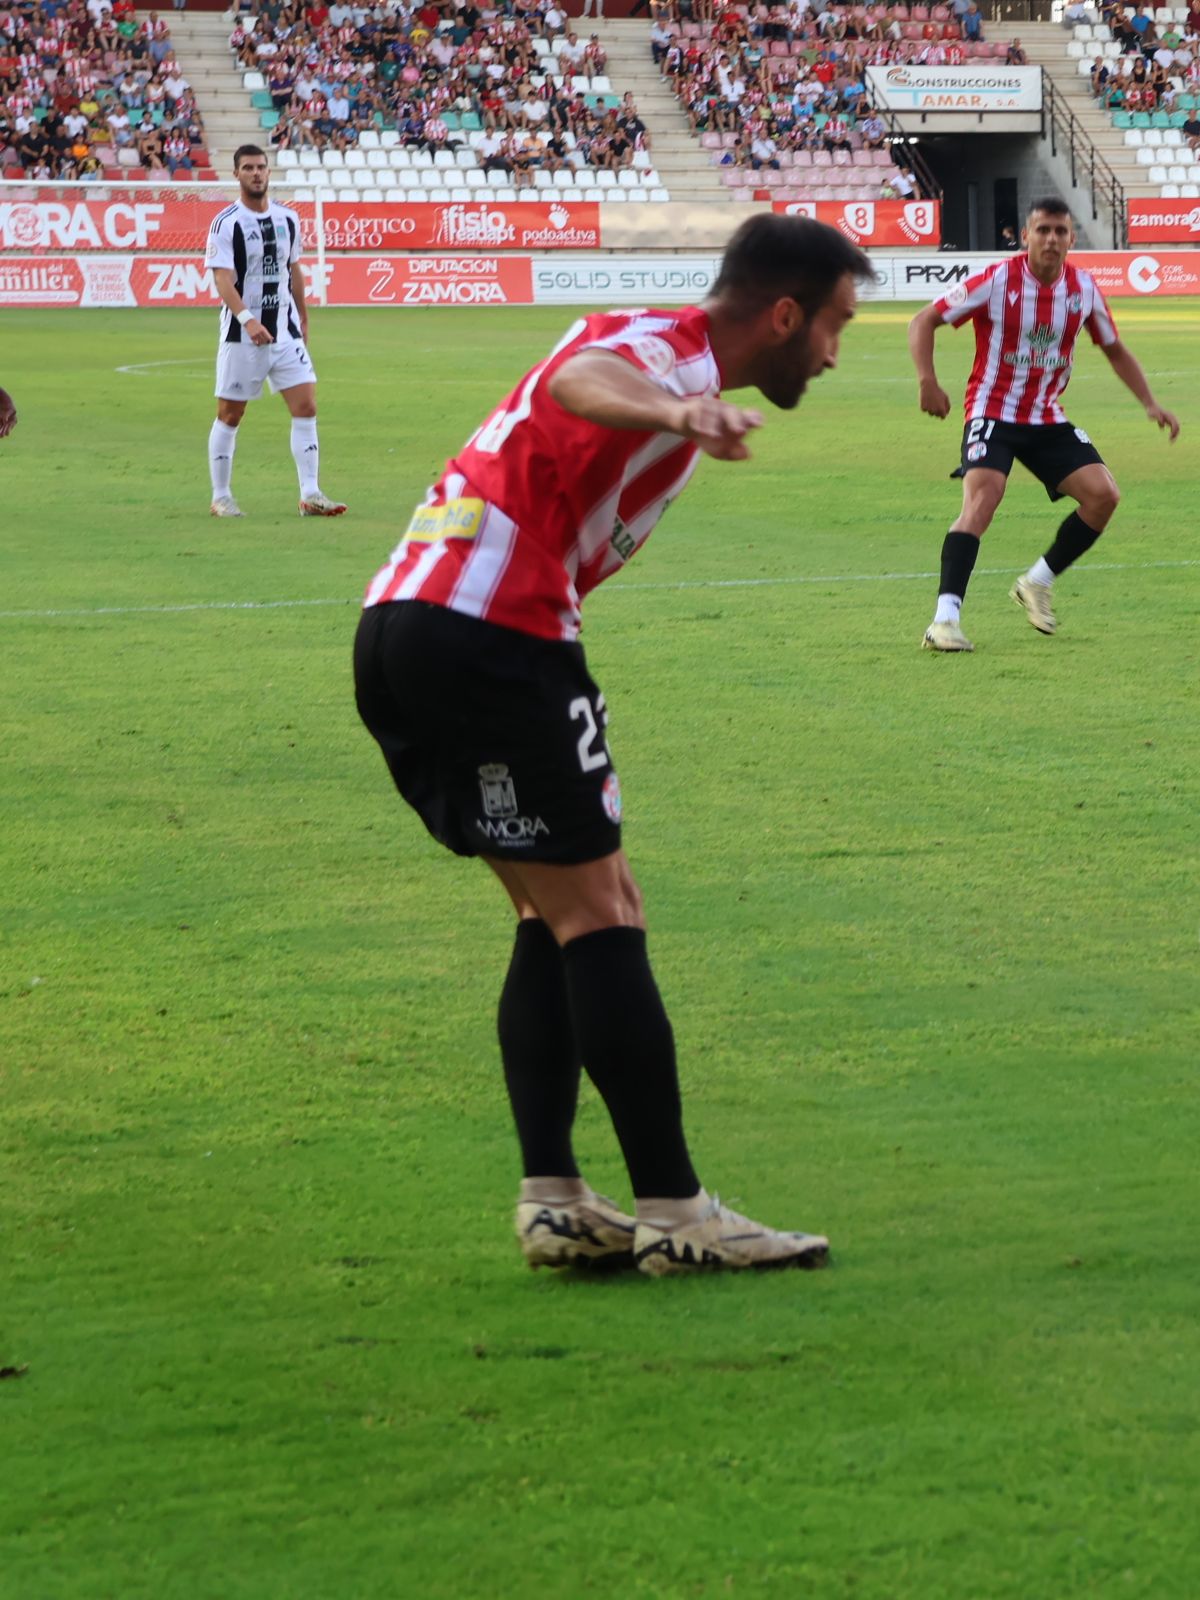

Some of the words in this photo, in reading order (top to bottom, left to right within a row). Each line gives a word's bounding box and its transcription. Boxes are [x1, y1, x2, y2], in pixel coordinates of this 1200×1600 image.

[887, 67, 1022, 88] CONSTRUCCIONES
[104, 203, 165, 247] CF
[344, 213, 416, 235] ÓPTICO
[449, 204, 507, 232] fisio
[855, 207, 867, 228] 8
[914, 207, 927, 228] 8
[837, 217, 861, 244] ZAMORA
[897, 217, 920, 244] ZAMORA
[538, 272, 611, 288] SOLID
[620, 272, 709, 288] STUDIO
[905, 265, 969, 283] PRM
[402, 282, 507, 302] ZAMORA
[967, 418, 996, 444] 21
